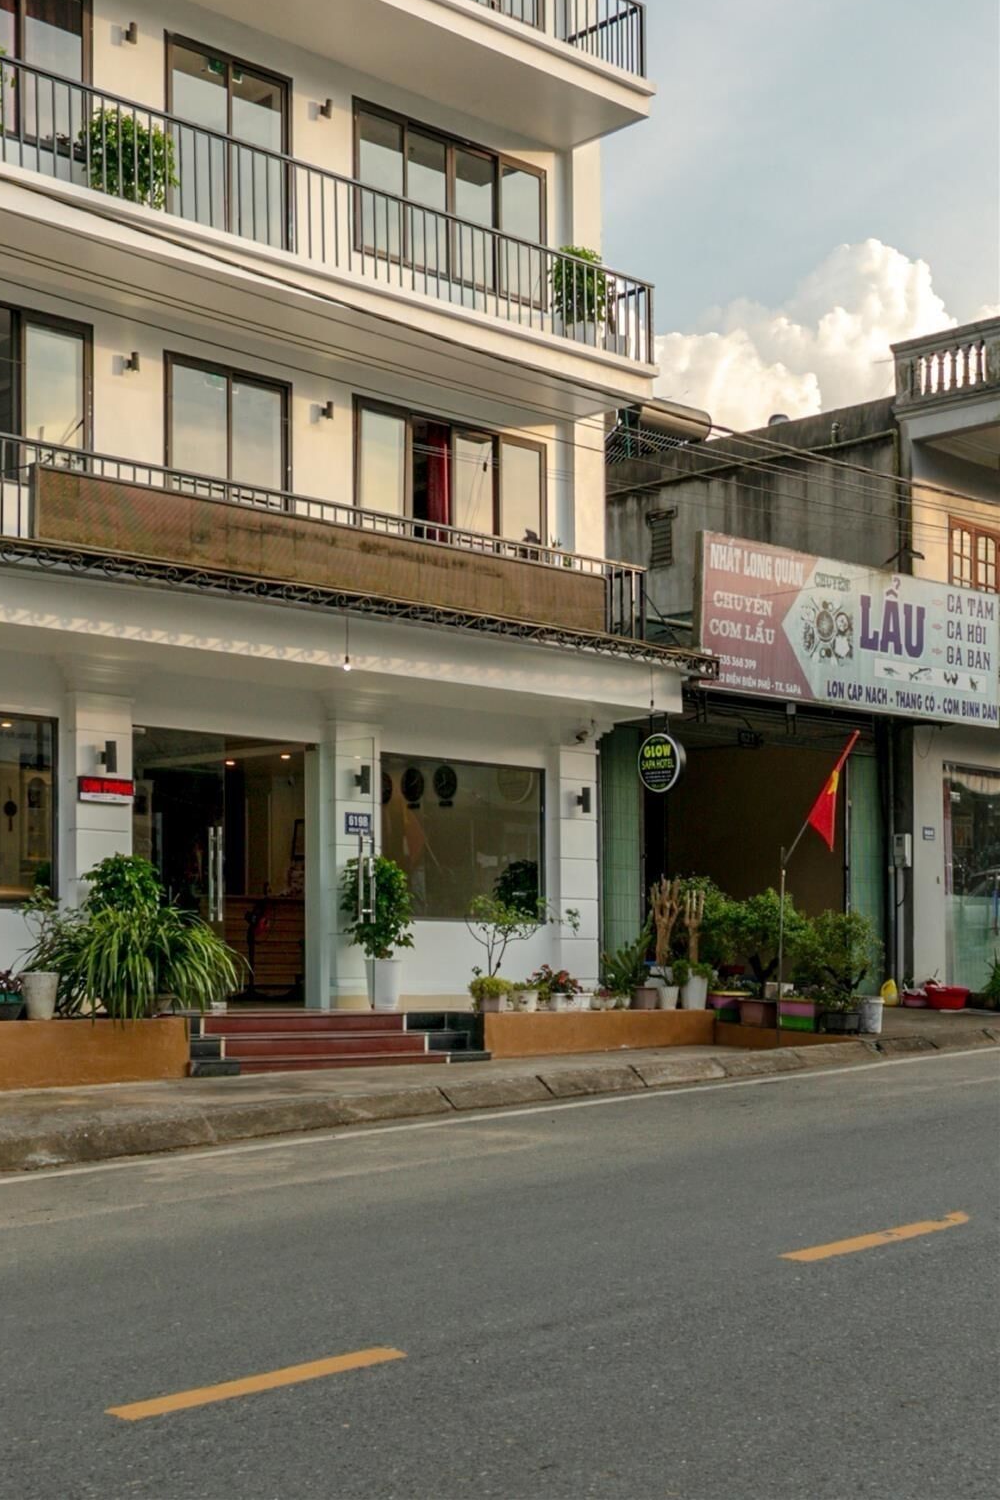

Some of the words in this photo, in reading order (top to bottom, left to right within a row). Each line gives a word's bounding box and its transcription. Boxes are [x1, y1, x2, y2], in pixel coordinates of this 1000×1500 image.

[743, 550, 773, 580] LONG
[859, 577, 926, 658] LẨU
[643, 744, 671, 758] GLOW
